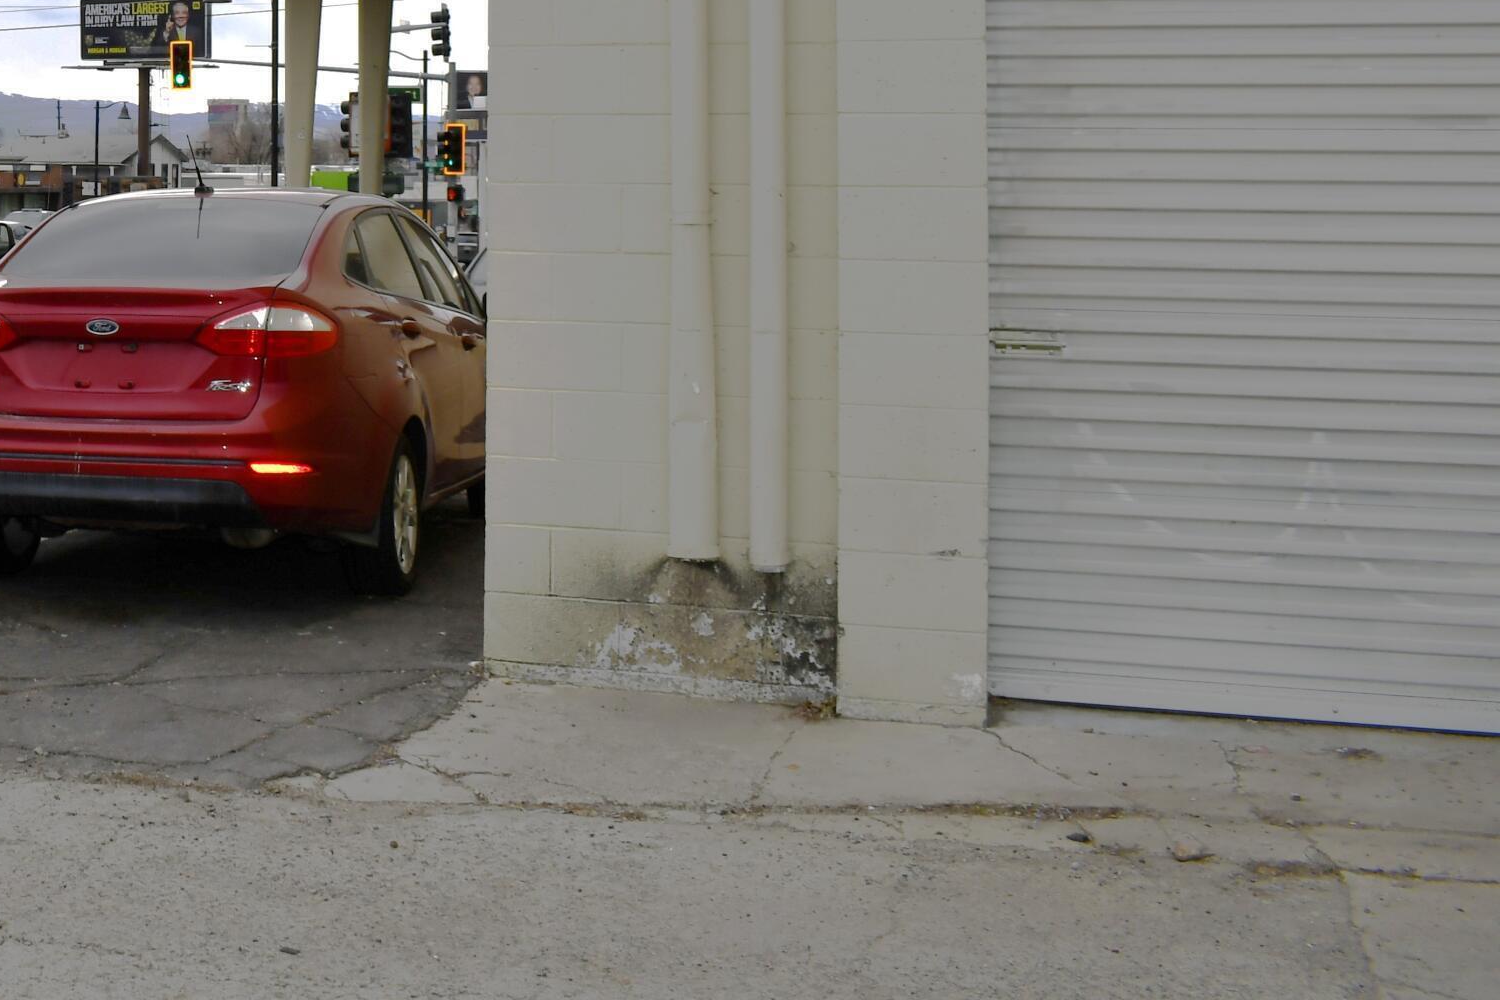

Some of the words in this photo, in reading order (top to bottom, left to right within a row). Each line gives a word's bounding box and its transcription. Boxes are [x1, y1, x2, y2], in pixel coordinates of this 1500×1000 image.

[85, 3, 130, 16] AMERICA'S
[131, 2, 170, 15] LARGEST
[85, 15, 114, 28] INJURY
[115, 15, 135, 27] LAW
[136, 14, 158, 27] FIRM
